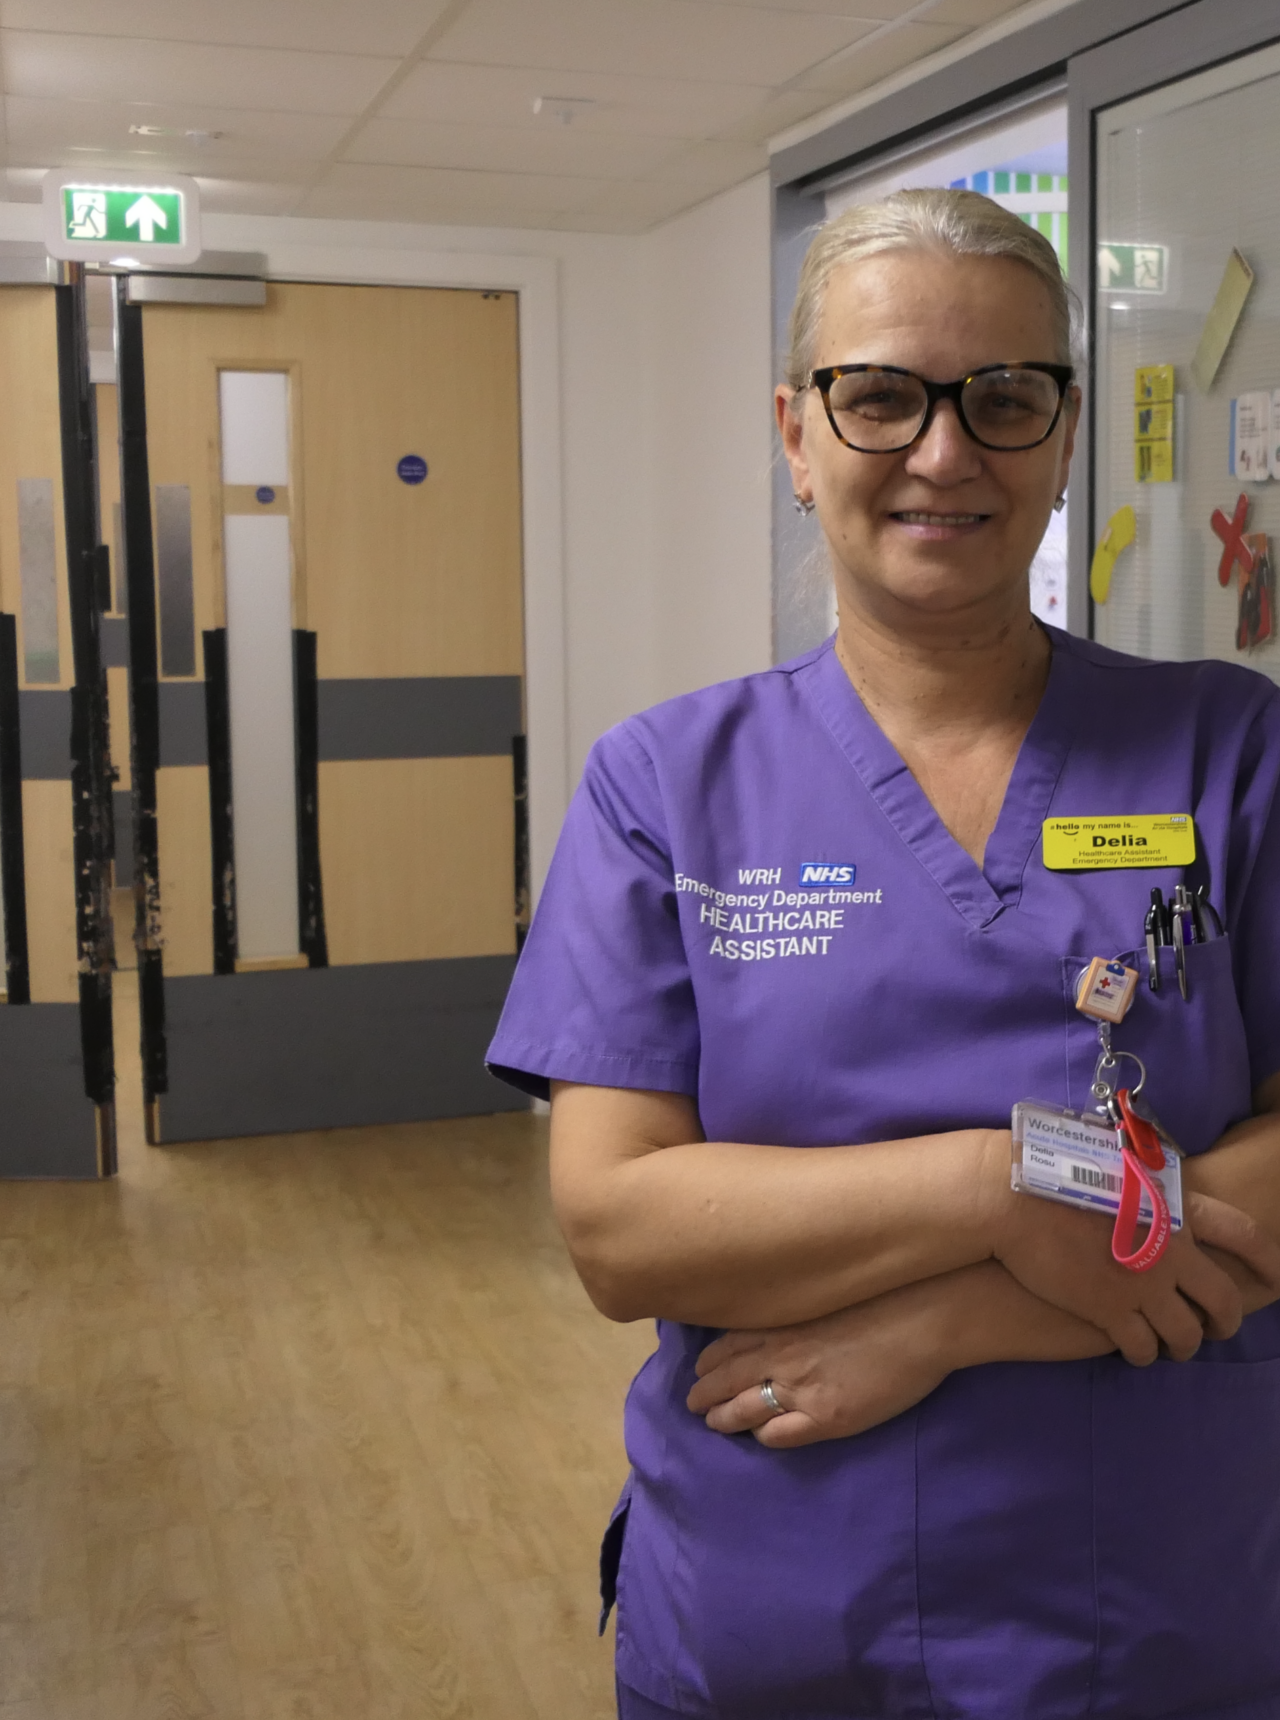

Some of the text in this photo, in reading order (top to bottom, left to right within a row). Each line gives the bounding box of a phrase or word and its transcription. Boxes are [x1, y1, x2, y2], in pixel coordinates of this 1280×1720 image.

[1092, 835, 1148, 848] Delia
[1072, 855, 1168, 865] Emergency Department
[1078, 848, 1161, 857] Healthcare Assistant
[738, 866, 854, 885] WRH NHS
[675, 873, 882, 910] Emergency Department
[700, 903, 845, 933] HEALTHCARE
[709, 936, 832, 960] ASSISTANT
[1030, 1144, 1055, 1157] Delia
[1030, 1155, 1055, 1167] Rosu
[1133, 1222, 1168, 1270] VALUABLE
